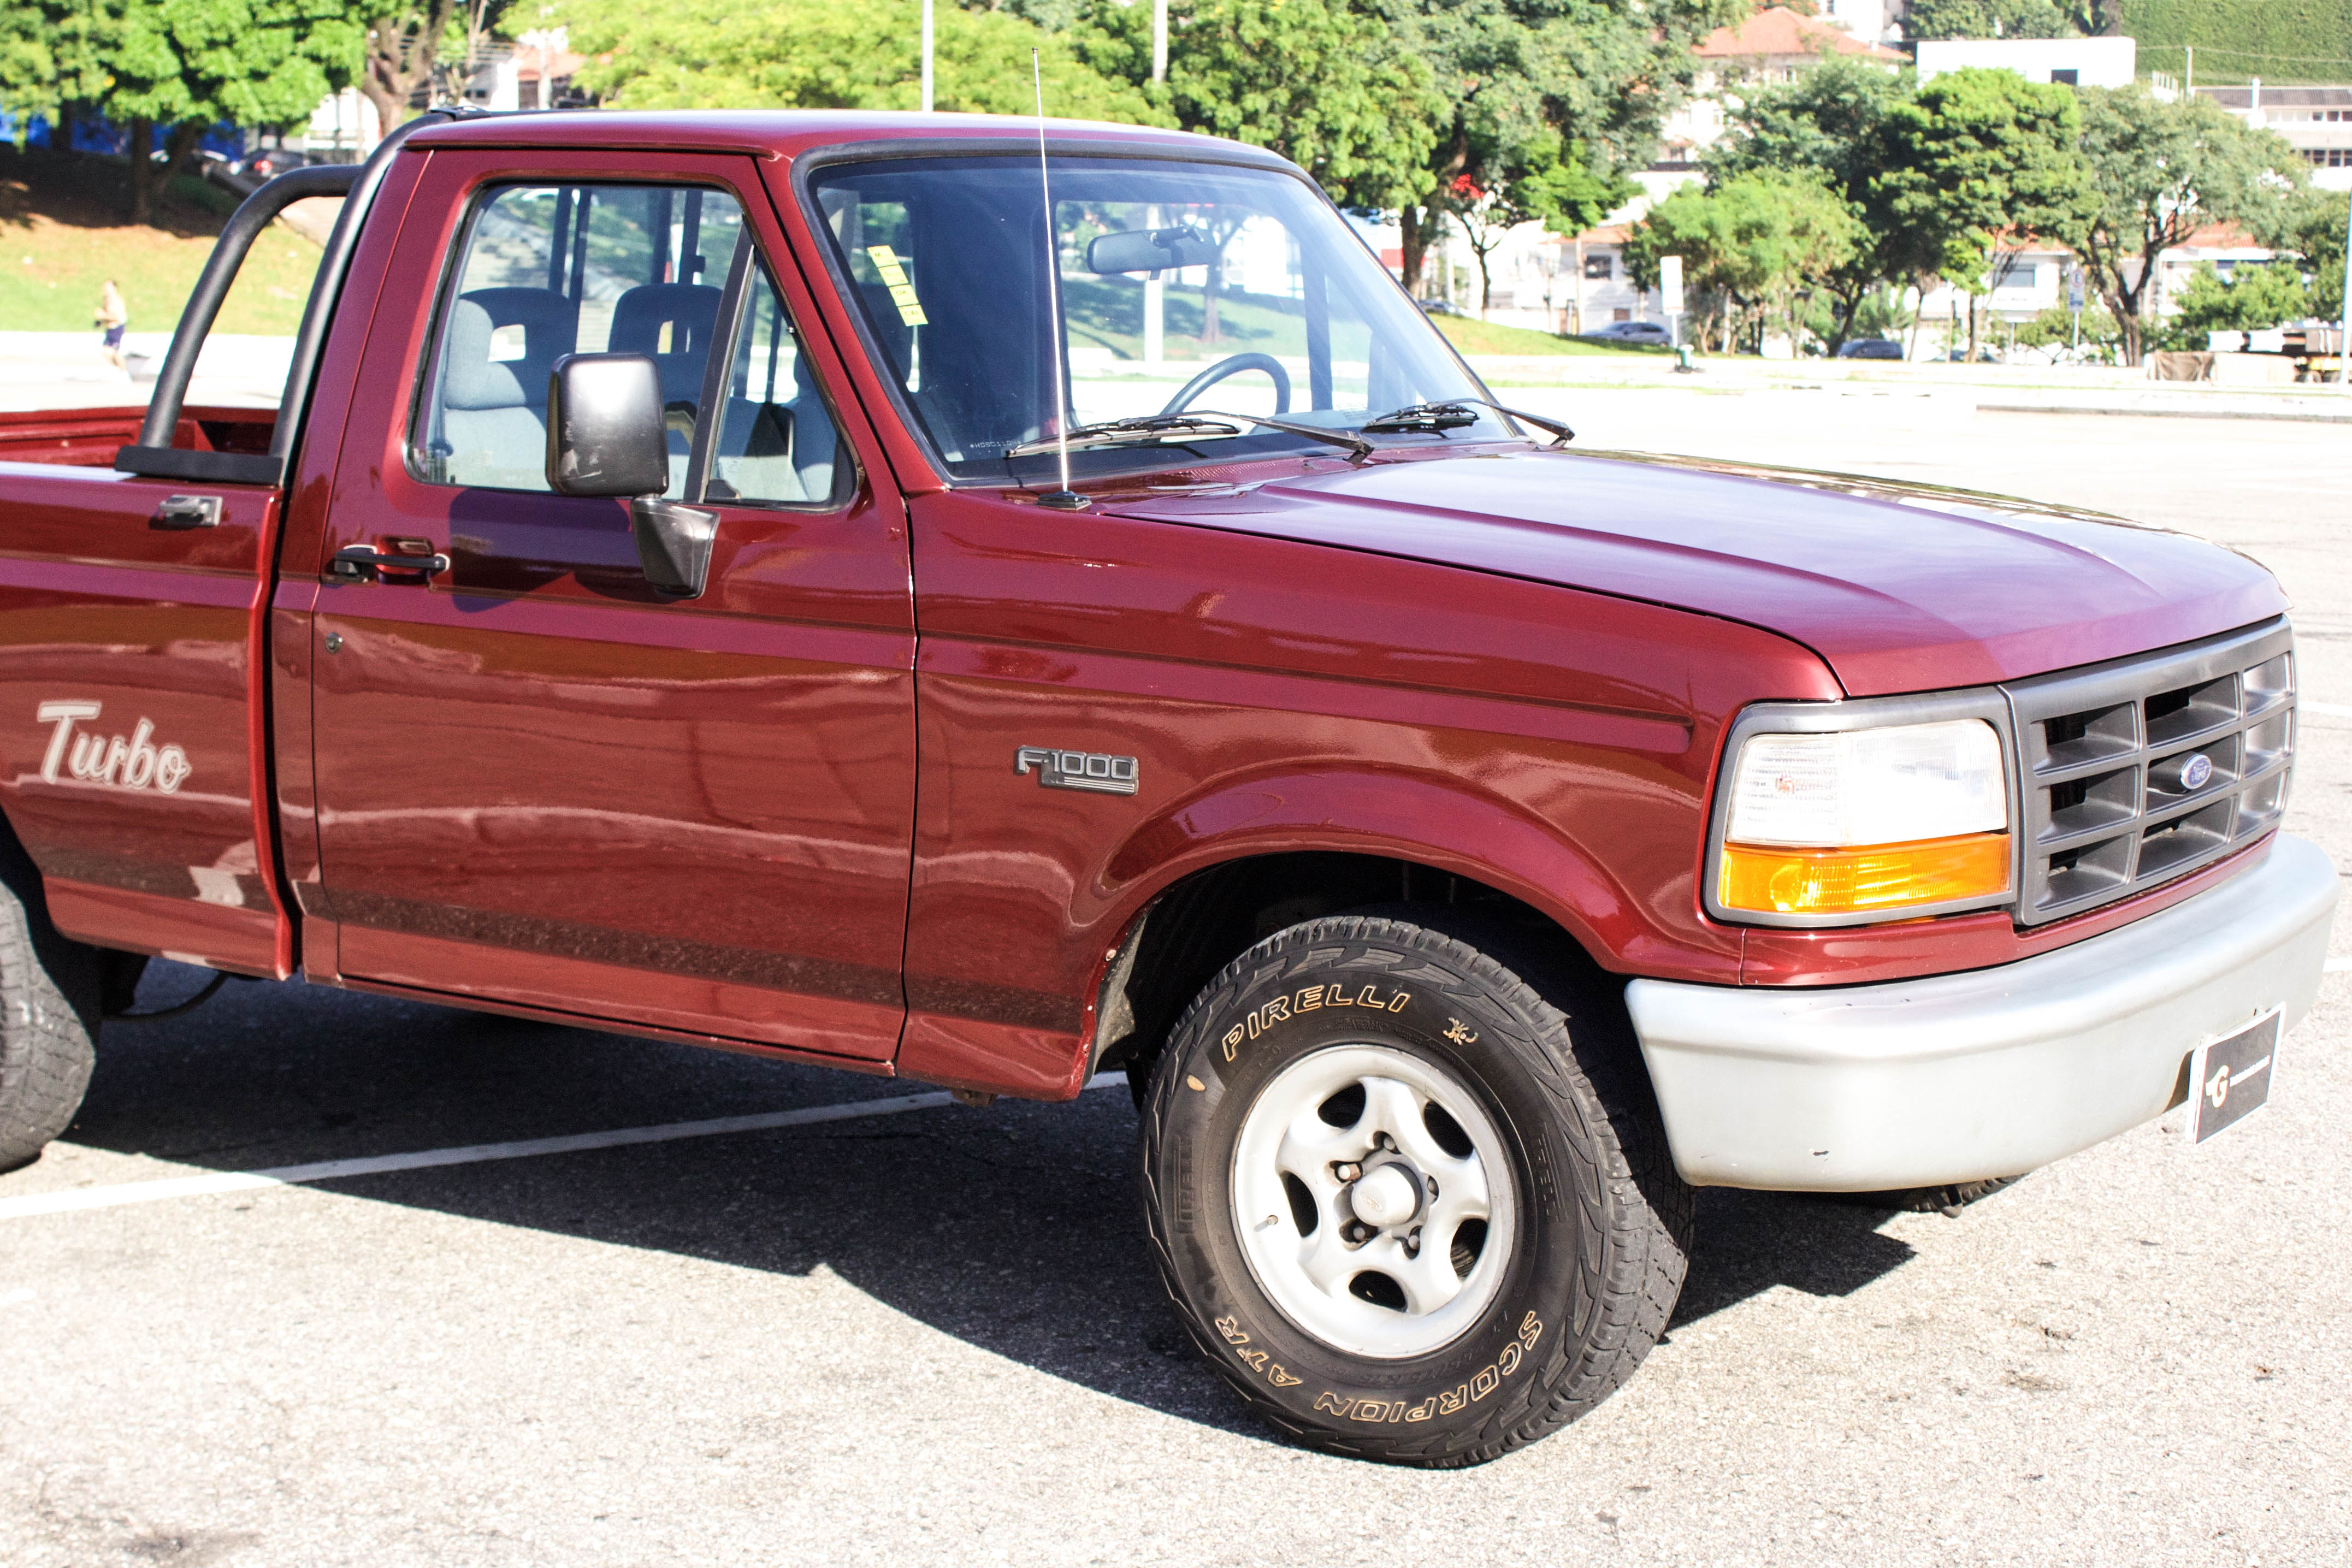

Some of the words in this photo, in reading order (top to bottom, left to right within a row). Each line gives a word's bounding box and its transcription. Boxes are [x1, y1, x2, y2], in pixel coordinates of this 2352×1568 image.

[37, 698, 193, 794] Turbo
[1221, 984, 1411, 1062] PIRELLI
[1214, 1316, 1303, 1387] ATR
[1313, 1310, 1543, 1423] SCORPION
